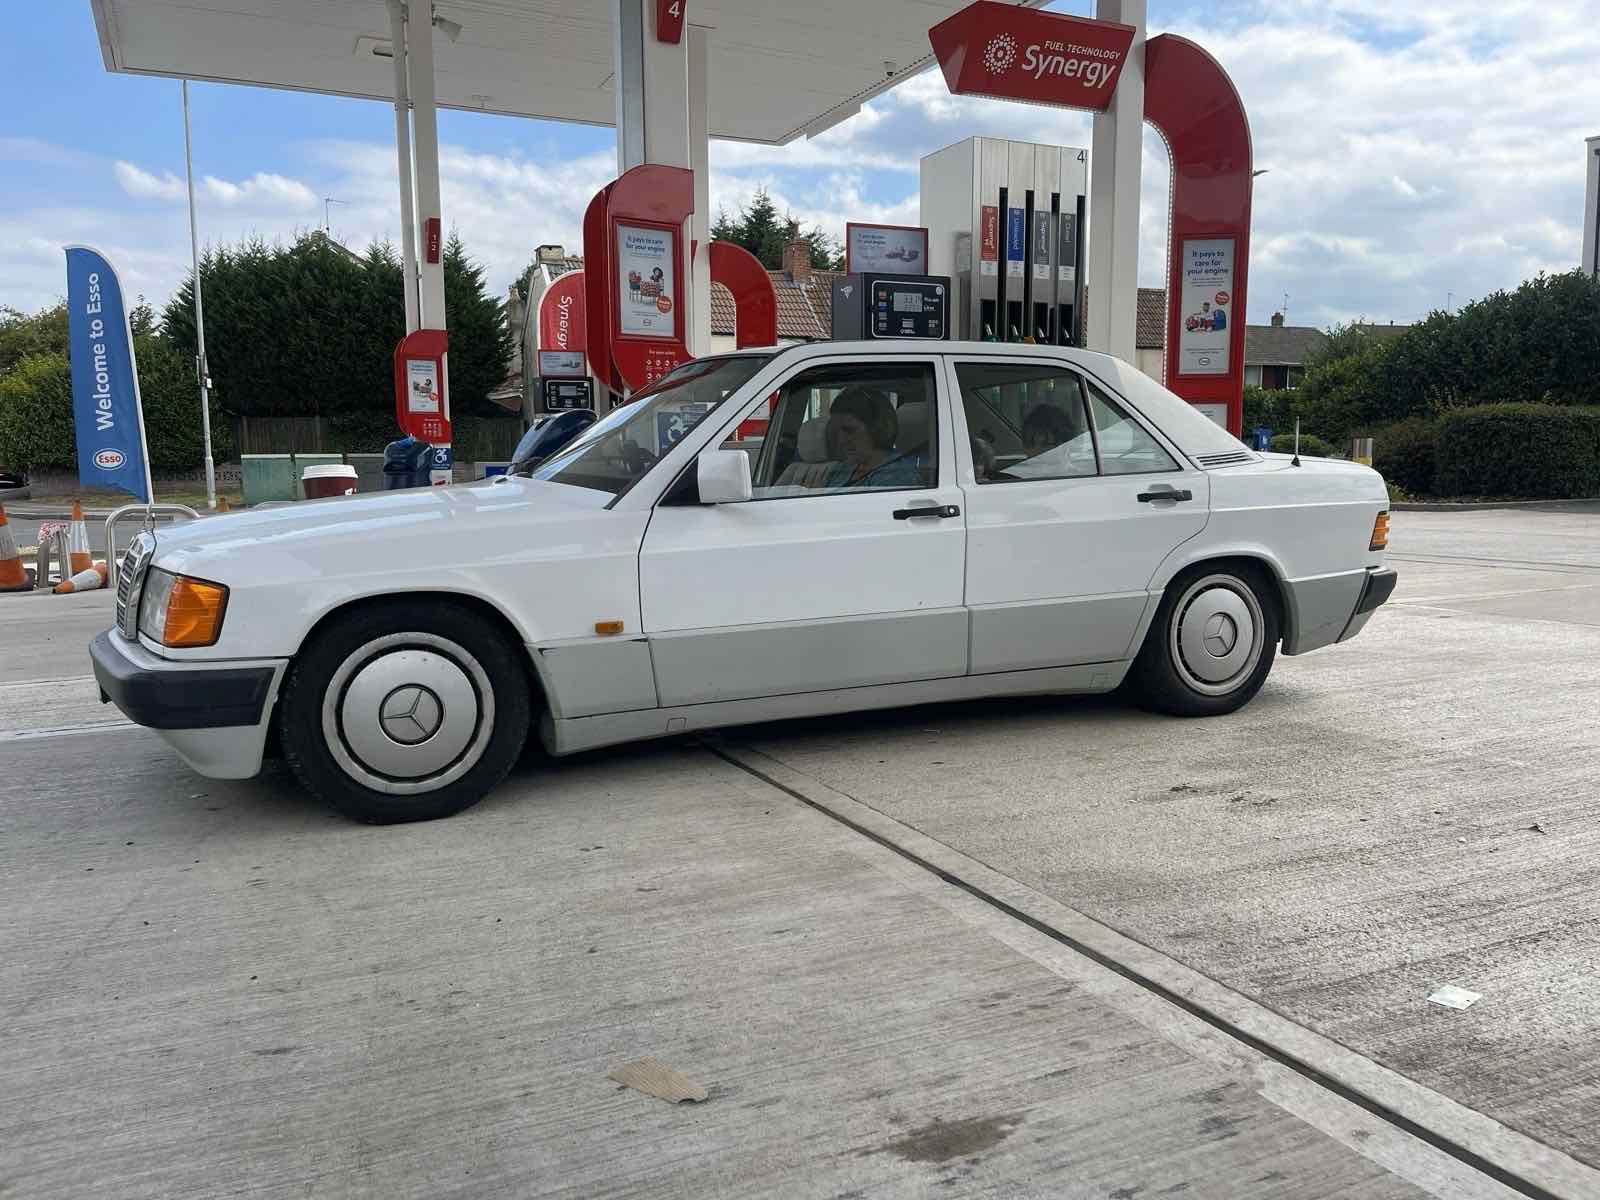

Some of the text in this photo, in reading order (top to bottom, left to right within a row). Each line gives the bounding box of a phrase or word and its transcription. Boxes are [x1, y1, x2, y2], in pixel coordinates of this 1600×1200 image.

[669, 1, 680, 18] 4
[1044, 40, 1121, 60] FUEL TECHNOLOGY
[1021, 45, 1117, 88] Synergy
[1076, 150, 1085, 164] 4
[647, 245, 665, 253] engine
[1199, 251, 1216, 259] pays
[1186, 268, 1229, 277] your engine
[557, 295, 573, 351] Synergy
[87, 272, 114, 431] Welcome to Esso
[98, 455, 121, 464] Esso
